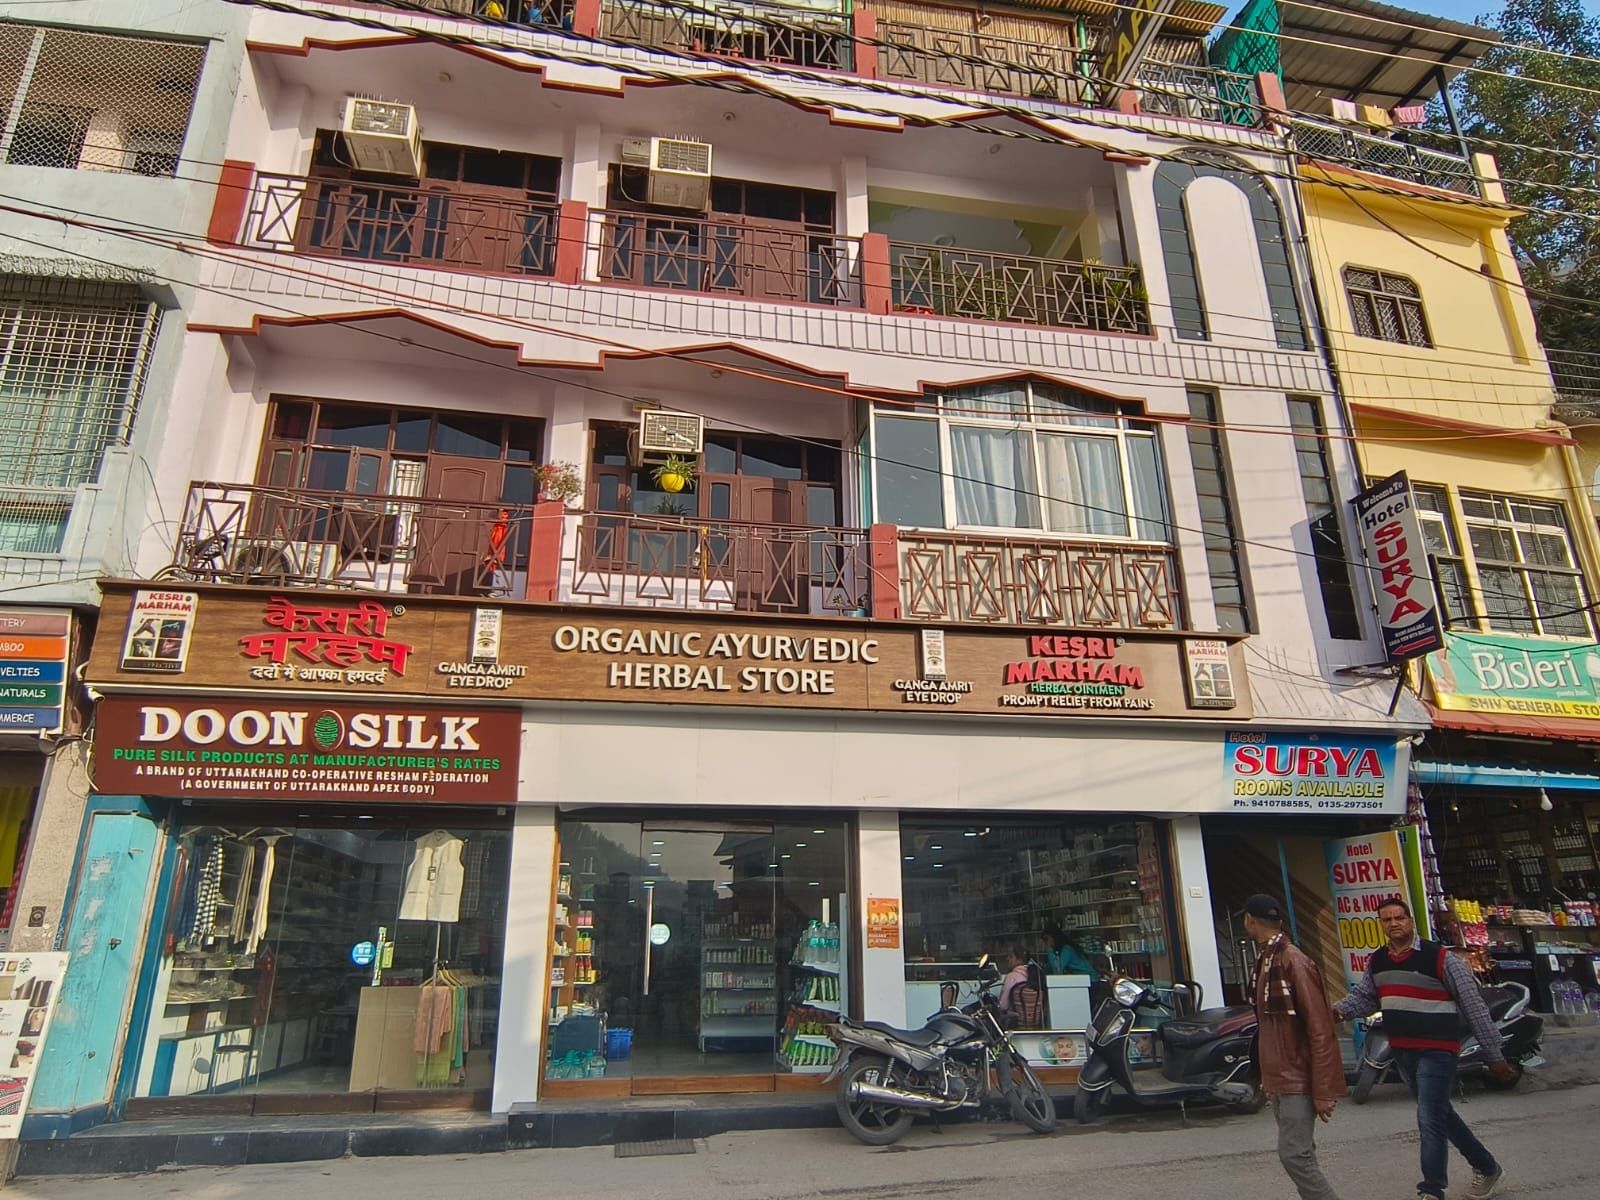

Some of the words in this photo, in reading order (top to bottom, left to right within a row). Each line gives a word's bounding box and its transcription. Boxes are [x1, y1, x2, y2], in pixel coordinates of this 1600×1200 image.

[1364, 495, 1410, 530] Hotel
[1373, 520, 1427, 624] SURYA
[149, 592, 184, 602] KESRI
[136, 601, 192, 612] MARHAM
[0, 618, 26, 628] TERY
[264, 596, 393, 637] केसरी
[554, 625, 701, 656] ORGANIC
[708, 632, 880, 663] AYURVEDIC
[1030, 635, 1116, 657] KESRI
[240, 631, 415, 676] मरहम
[0, 667, 41, 677] VELTIES
[300, 668, 343, 682] आपका
[346, 668, 388, 684] हमदर्द
[438, 661, 485, 675] GANGA
[487, 664, 528, 676] AMRIT
[1007, 660, 1145, 687] MARHAM
[1471, 649, 1582, 690] Bisleri
[609, 662, 732, 690] HERBAL
[741, 667, 836, 694] STORE
[895, 679, 938, 690] GANGA
[939, 681, 975, 692] AMRIT
[1031, 683, 1073, 694] HERBAL
[1074, 684, 1128, 695] OINTMENT
[1003, 695, 1051, 706] PROMPT
[1051, 696, 1088, 707] RELIEF
[1089, 697, 1122, 708] FROM
[1124, 698, 1156, 709] PAINS
[1471, 697, 1503, 709] SHIV
[1507, 699, 1571, 714] GENERAL
[1573, 703, 1600, 717] STO
[139, 706, 309, 746] DOON
[348, 713, 481, 750] SILK
[1230, 731, 1267, 743] Hotel
[113, 748, 156, 761] PURE
[160, 750, 196, 762] SILK
[201, 751, 285, 765] PRODUCTS
[289, 754, 309, 765] AT
[454, 758, 500, 770] RATES
[1233, 745, 1385, 778] SURYA
[136, 765, 143, 775] A
[146, 765, 185, 776] BRAND
[188, 766, 202, 776] OF
[206, 767, 289, 778] UTTARAKHAND
[292, 769, 373, 781] CO-OPERATIVE
[376, 771, 420, 782] RESHAM
[422, 771, 489, 783] FEDERATION
[180, 779, 192, 790] (A
[195, 780, 271, 791] GOVERNMENT
[273, 781, 287, 791] OF
[290, 782, 370, 793] UTTARAKHAND
[372, 783, 400, 793] APEX
[402, 784, 435, 795] BODY)
[1233, 779, 1293, 796] ROOMS
[1295, 781, 1385, 798] AVAILABLE
[1233, 799, 1249, 807] Ph.
[1346, 842, 1373, 857] Hotel
[1332, 858, 1398, 886] SURYA
[1337, 896, 1351, 913] AC
